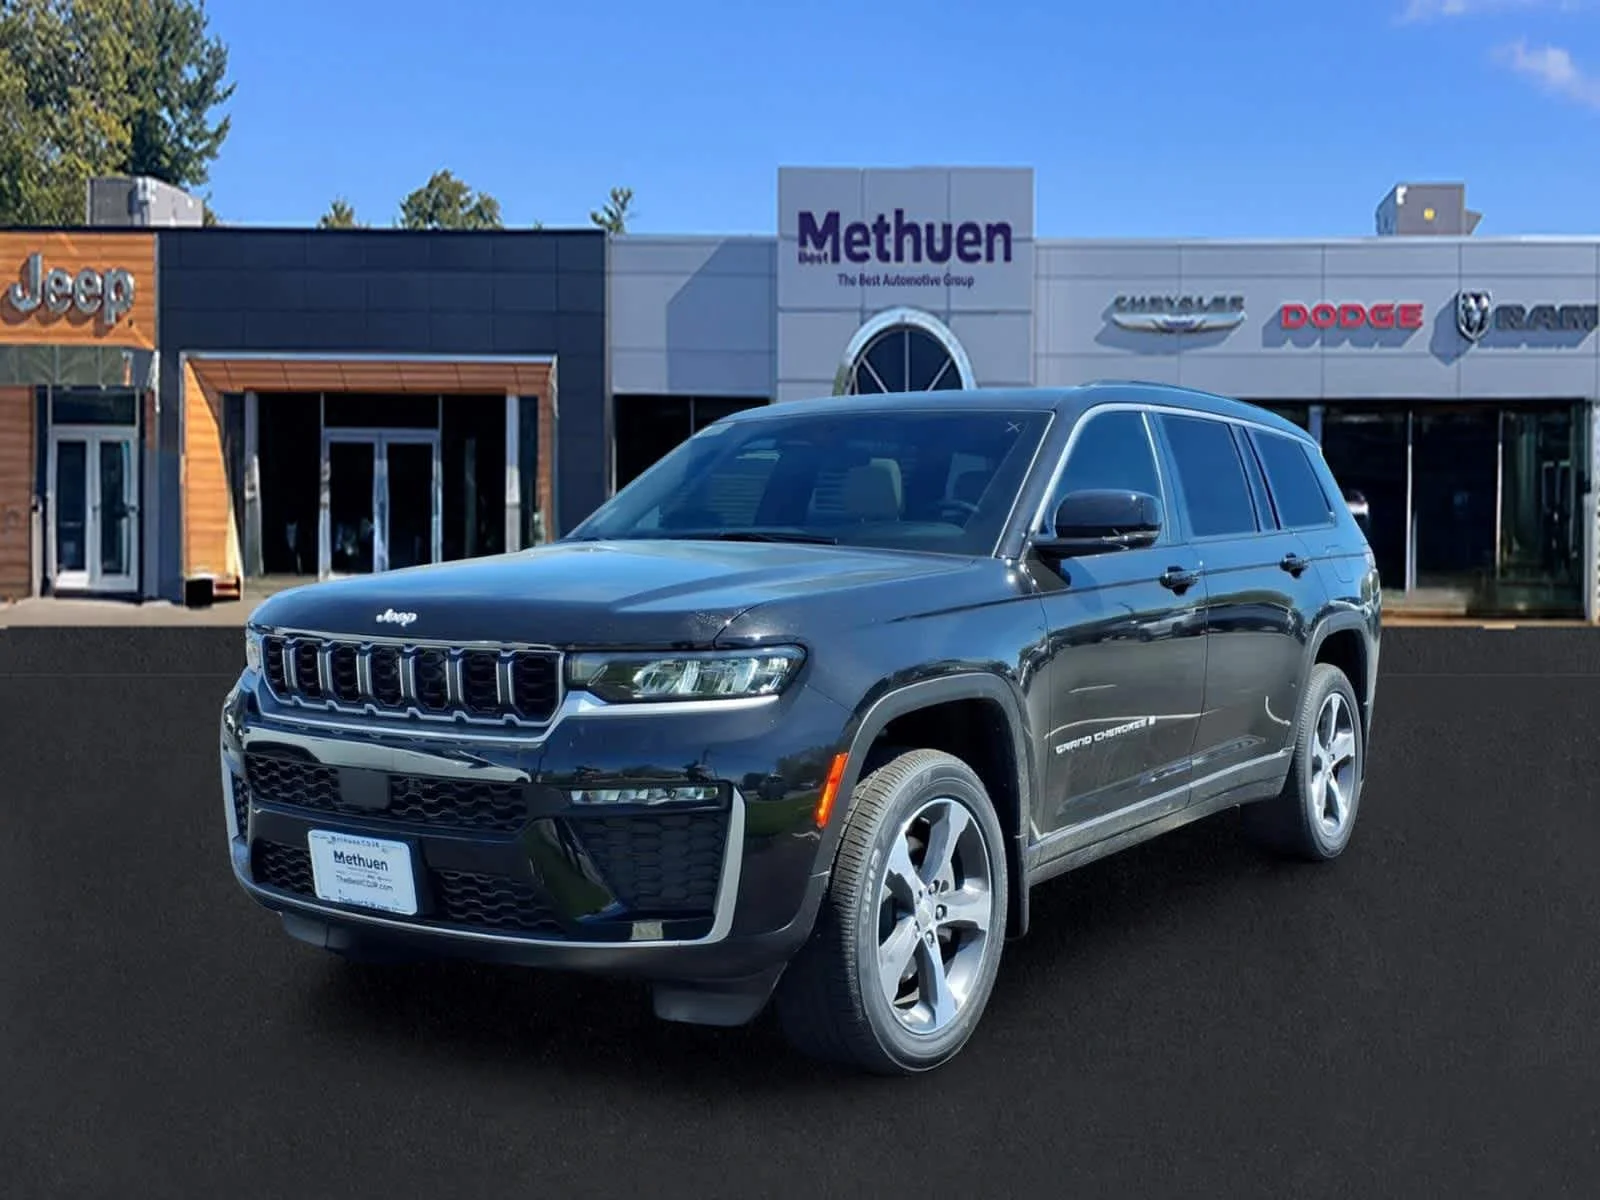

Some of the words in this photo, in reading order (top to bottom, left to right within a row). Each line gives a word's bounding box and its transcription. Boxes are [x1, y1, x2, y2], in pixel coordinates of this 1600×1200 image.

[797, 208, 1013, 263] Methuen
[9, 252, 136, 325] Jeep
[837, 273, 857, 286] The
[859, 273, 880, 286] Best
[883, 273, 941, 286] Automotive
[943, 272, 974, 289] Group
[1281, 304, 1423, 328] DODGE
[1495, 304, 1599, 331] RAM
[376, 608, 417, 627] Jeep
[333, 850, 388, 871] Methuen
